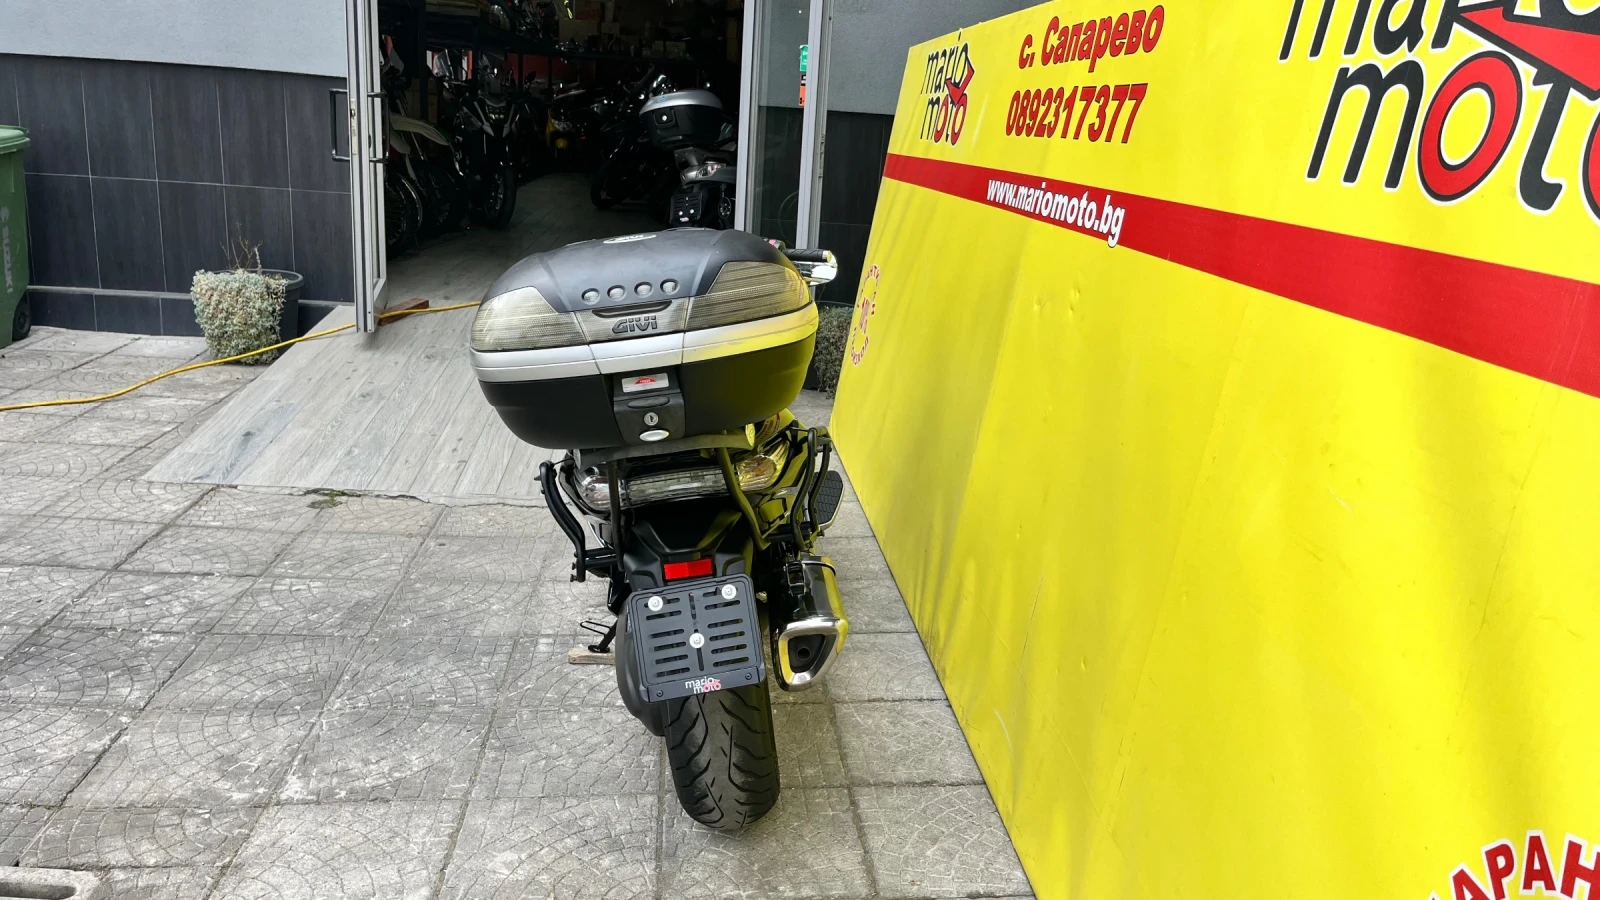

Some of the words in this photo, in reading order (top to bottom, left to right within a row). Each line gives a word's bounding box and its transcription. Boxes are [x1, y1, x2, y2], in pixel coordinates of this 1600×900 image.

[920, 31, 968, 93] mario
[1041, 5, 1165, 73] Сапарево
[920, 93, 968, 146] moto
[1005, 83, 1148, 144] 0892317377
[1306, 50, 1600, 220] mot
[986, 180, 1126, 248] www.mariomoto.bg
[685, 676, 714, 689] mario
[693, 684, 721, 694] moto
[1431, 834, 1600, 900] АРАН
